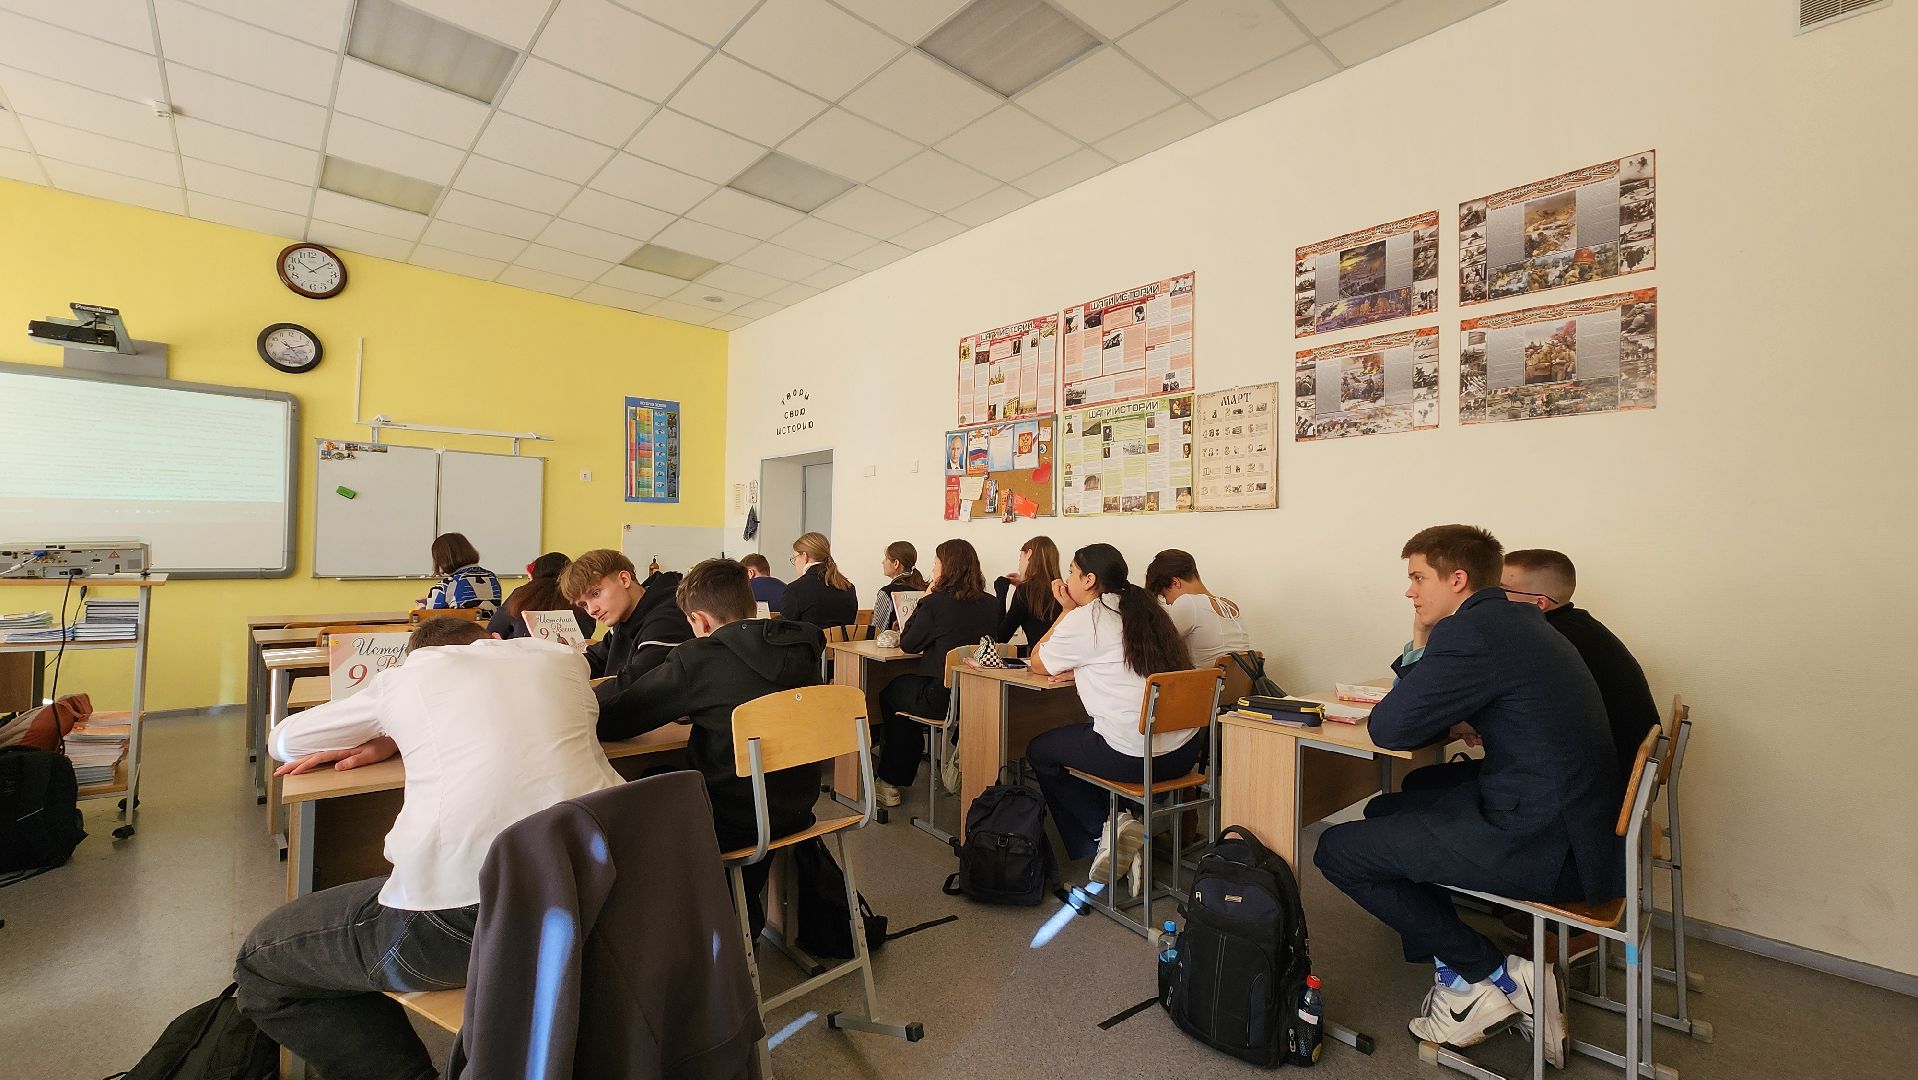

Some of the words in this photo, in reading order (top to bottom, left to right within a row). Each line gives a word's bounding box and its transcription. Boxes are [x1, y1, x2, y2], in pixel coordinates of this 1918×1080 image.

[1090, 296, 1114, 310] ШАГИ
[1115, 284, 1160, 304] ИСТОРИИ
[75, 304, 114, 314] Promethean
[1000, 321, 1033, 336] ИСТОРИИ
[1220, 392, 1252, 406] МАРТ
[784, 408, 806, 419] СВОЮ
[1088, 408, 1112, 419] ШАГИ
[1114, 401, 1160, 415] ИСТОРИИ
[776, 420, 814, 435] ИСТОРИЮ
[902, 606, 909, 617] 9
[540, 628, 549, 639] 9
[346, 664, 368, 689] 9
